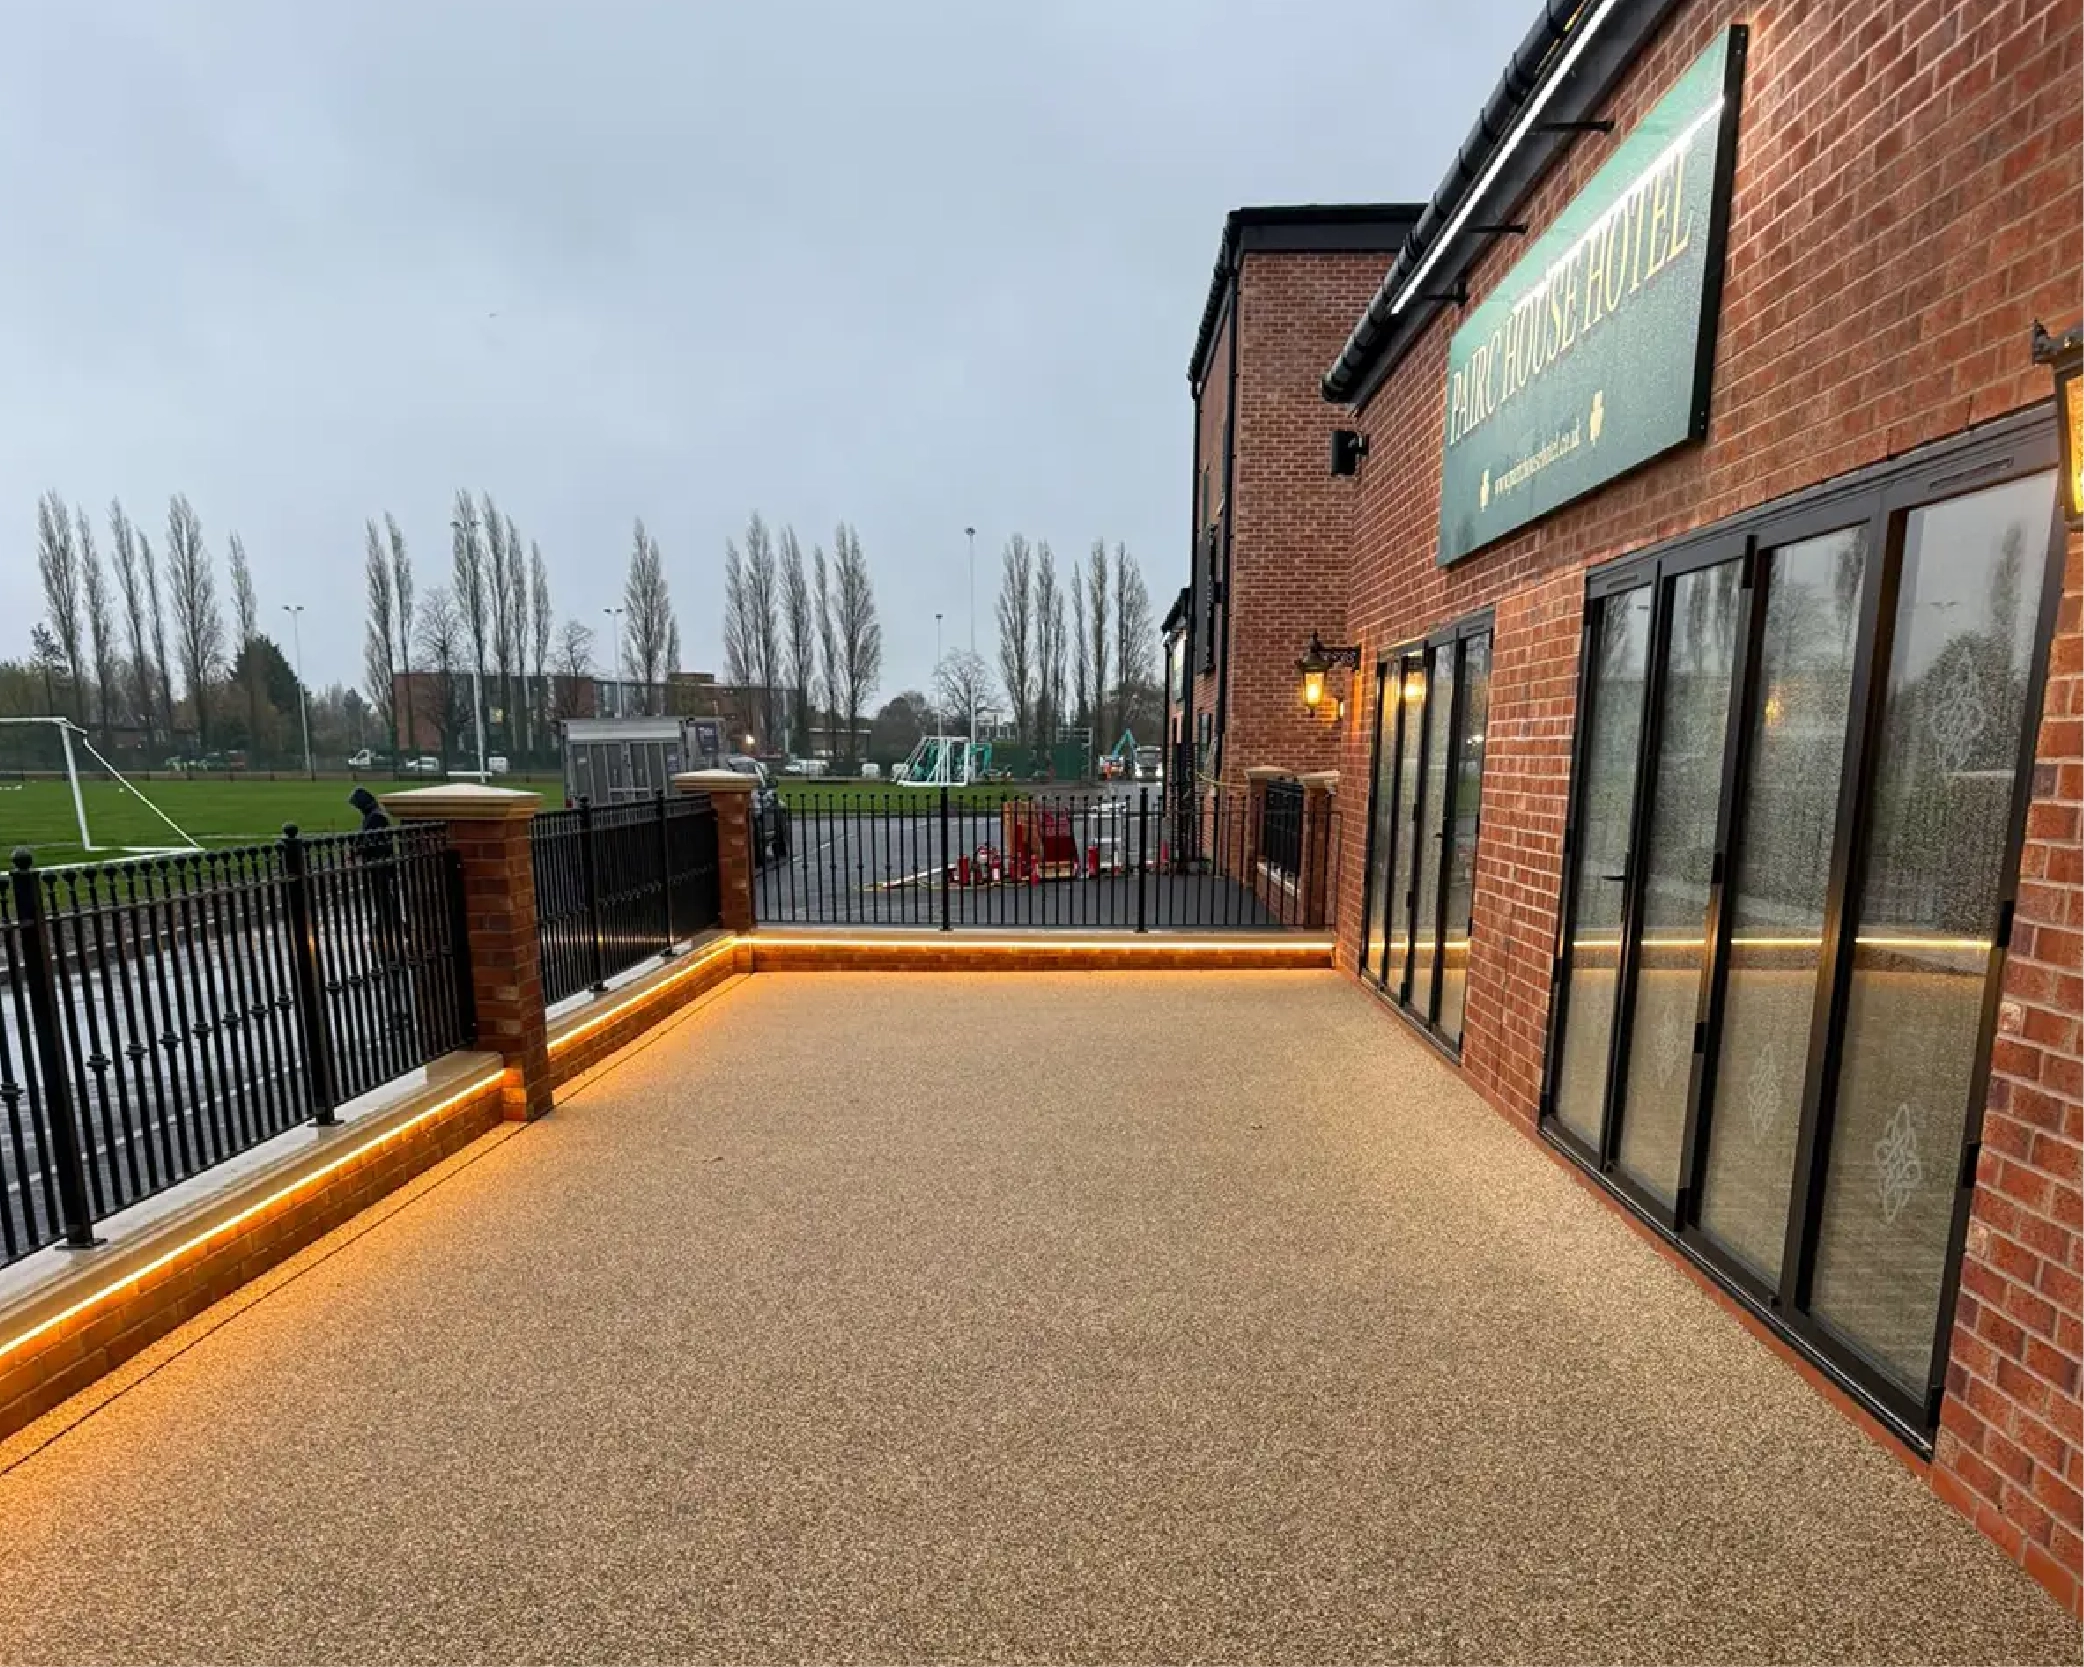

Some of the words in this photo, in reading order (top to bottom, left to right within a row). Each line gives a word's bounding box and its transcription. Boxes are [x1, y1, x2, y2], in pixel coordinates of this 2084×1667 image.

[1449, 329, 1502, 446] PAIRC
[1501, 252, 1578, 404] HOUSE
[1582, 147, 1694, 332] HOTEL
